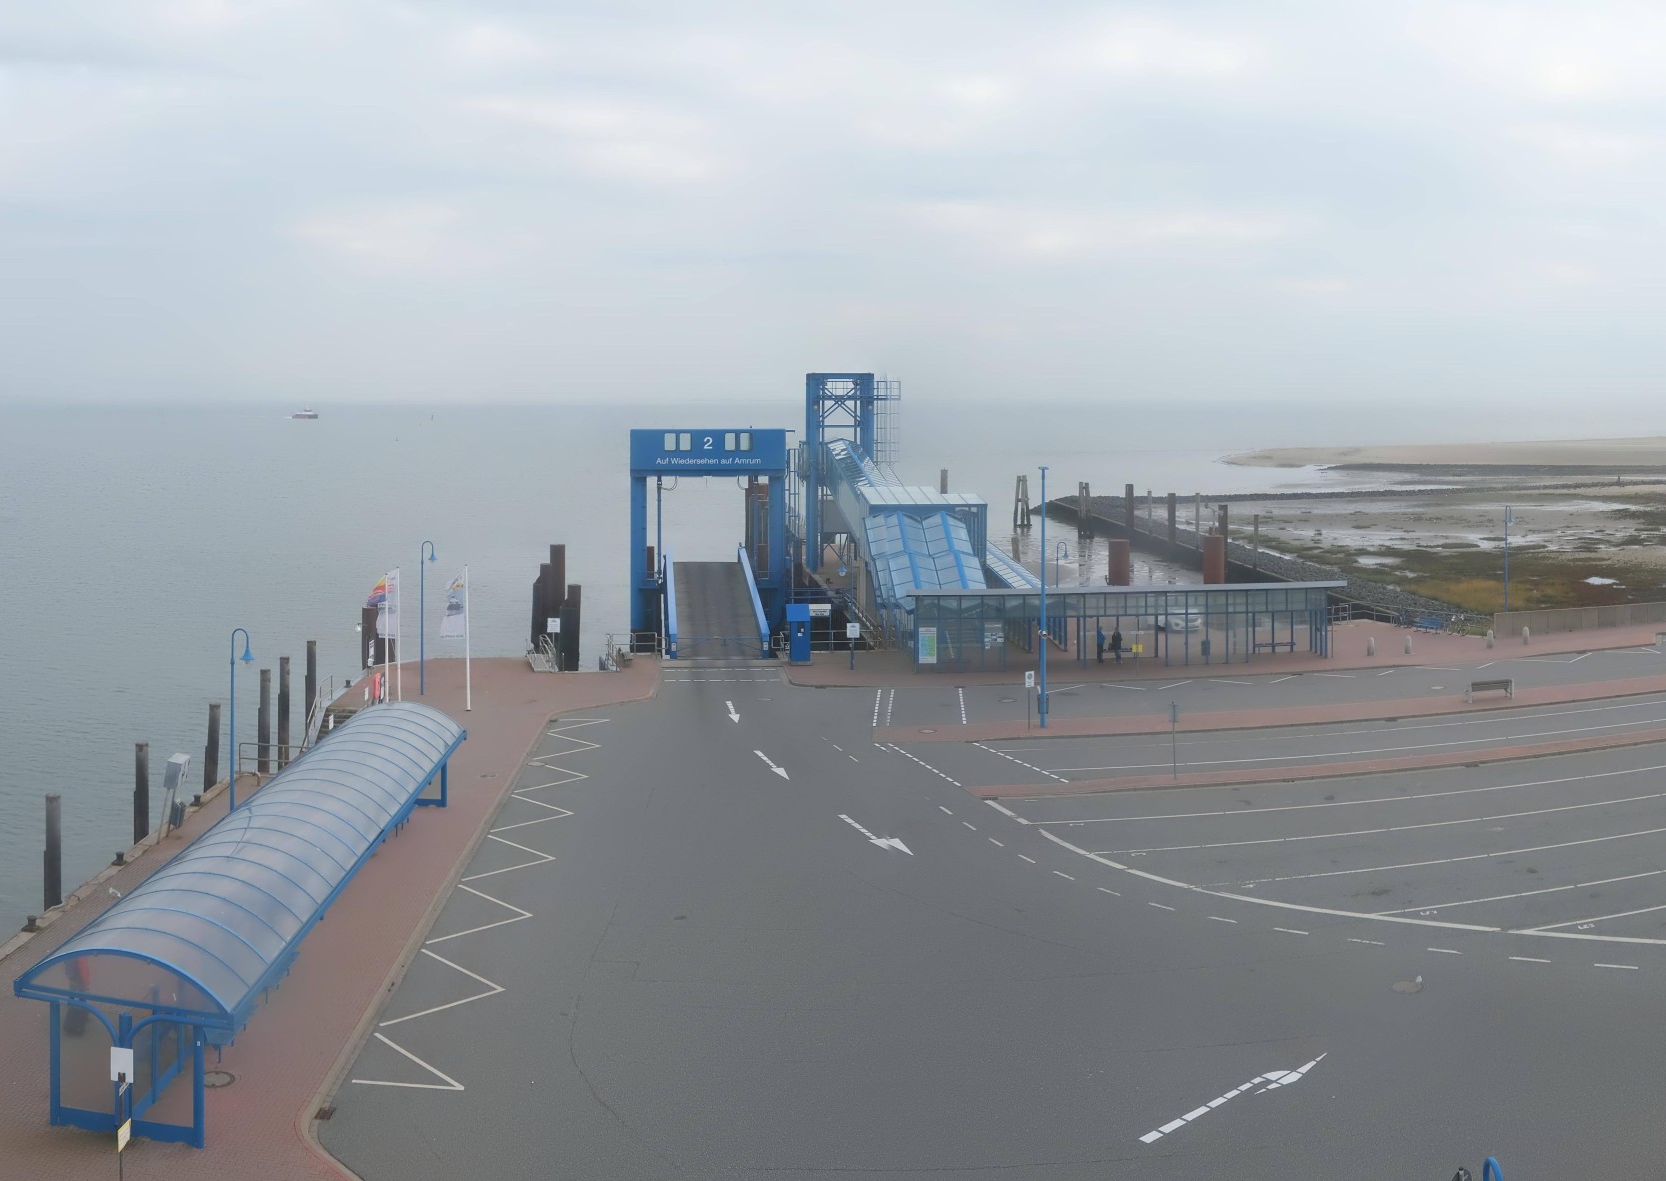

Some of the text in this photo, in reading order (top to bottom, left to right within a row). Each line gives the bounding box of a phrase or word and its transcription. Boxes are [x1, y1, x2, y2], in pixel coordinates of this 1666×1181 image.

[703, 437, 713, 449] 2
[655, 457, 761, 465] Auf Wiedersehen auf Amrum
